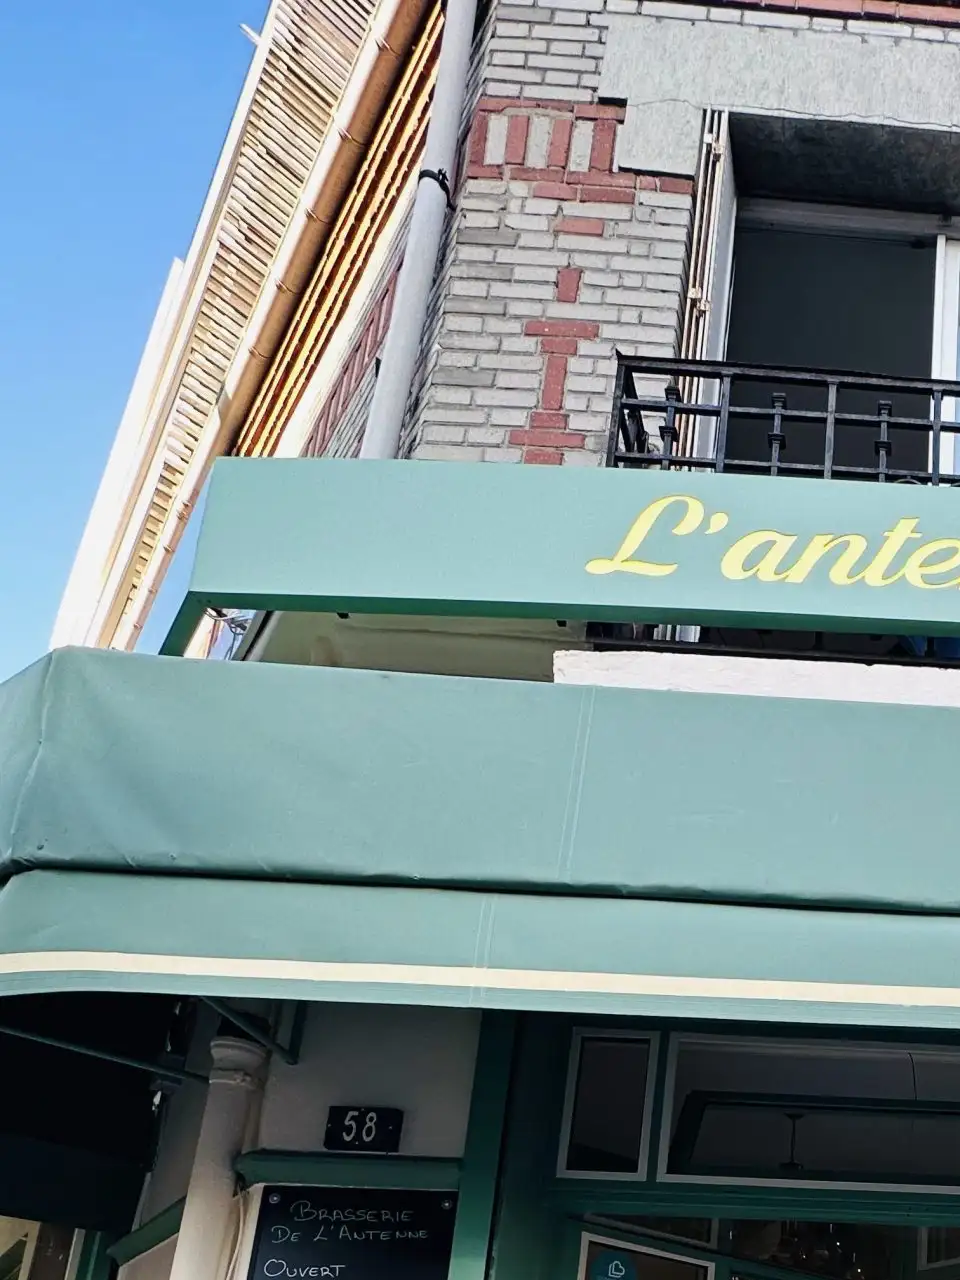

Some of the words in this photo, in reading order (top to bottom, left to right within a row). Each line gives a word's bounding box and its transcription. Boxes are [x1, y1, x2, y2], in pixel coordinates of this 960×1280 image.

[343, 1111, 377, 1141] 58
[290, 1200, 414, 1222] BRASSERIE
[264, 1259, 345, 1277] OUVERT
